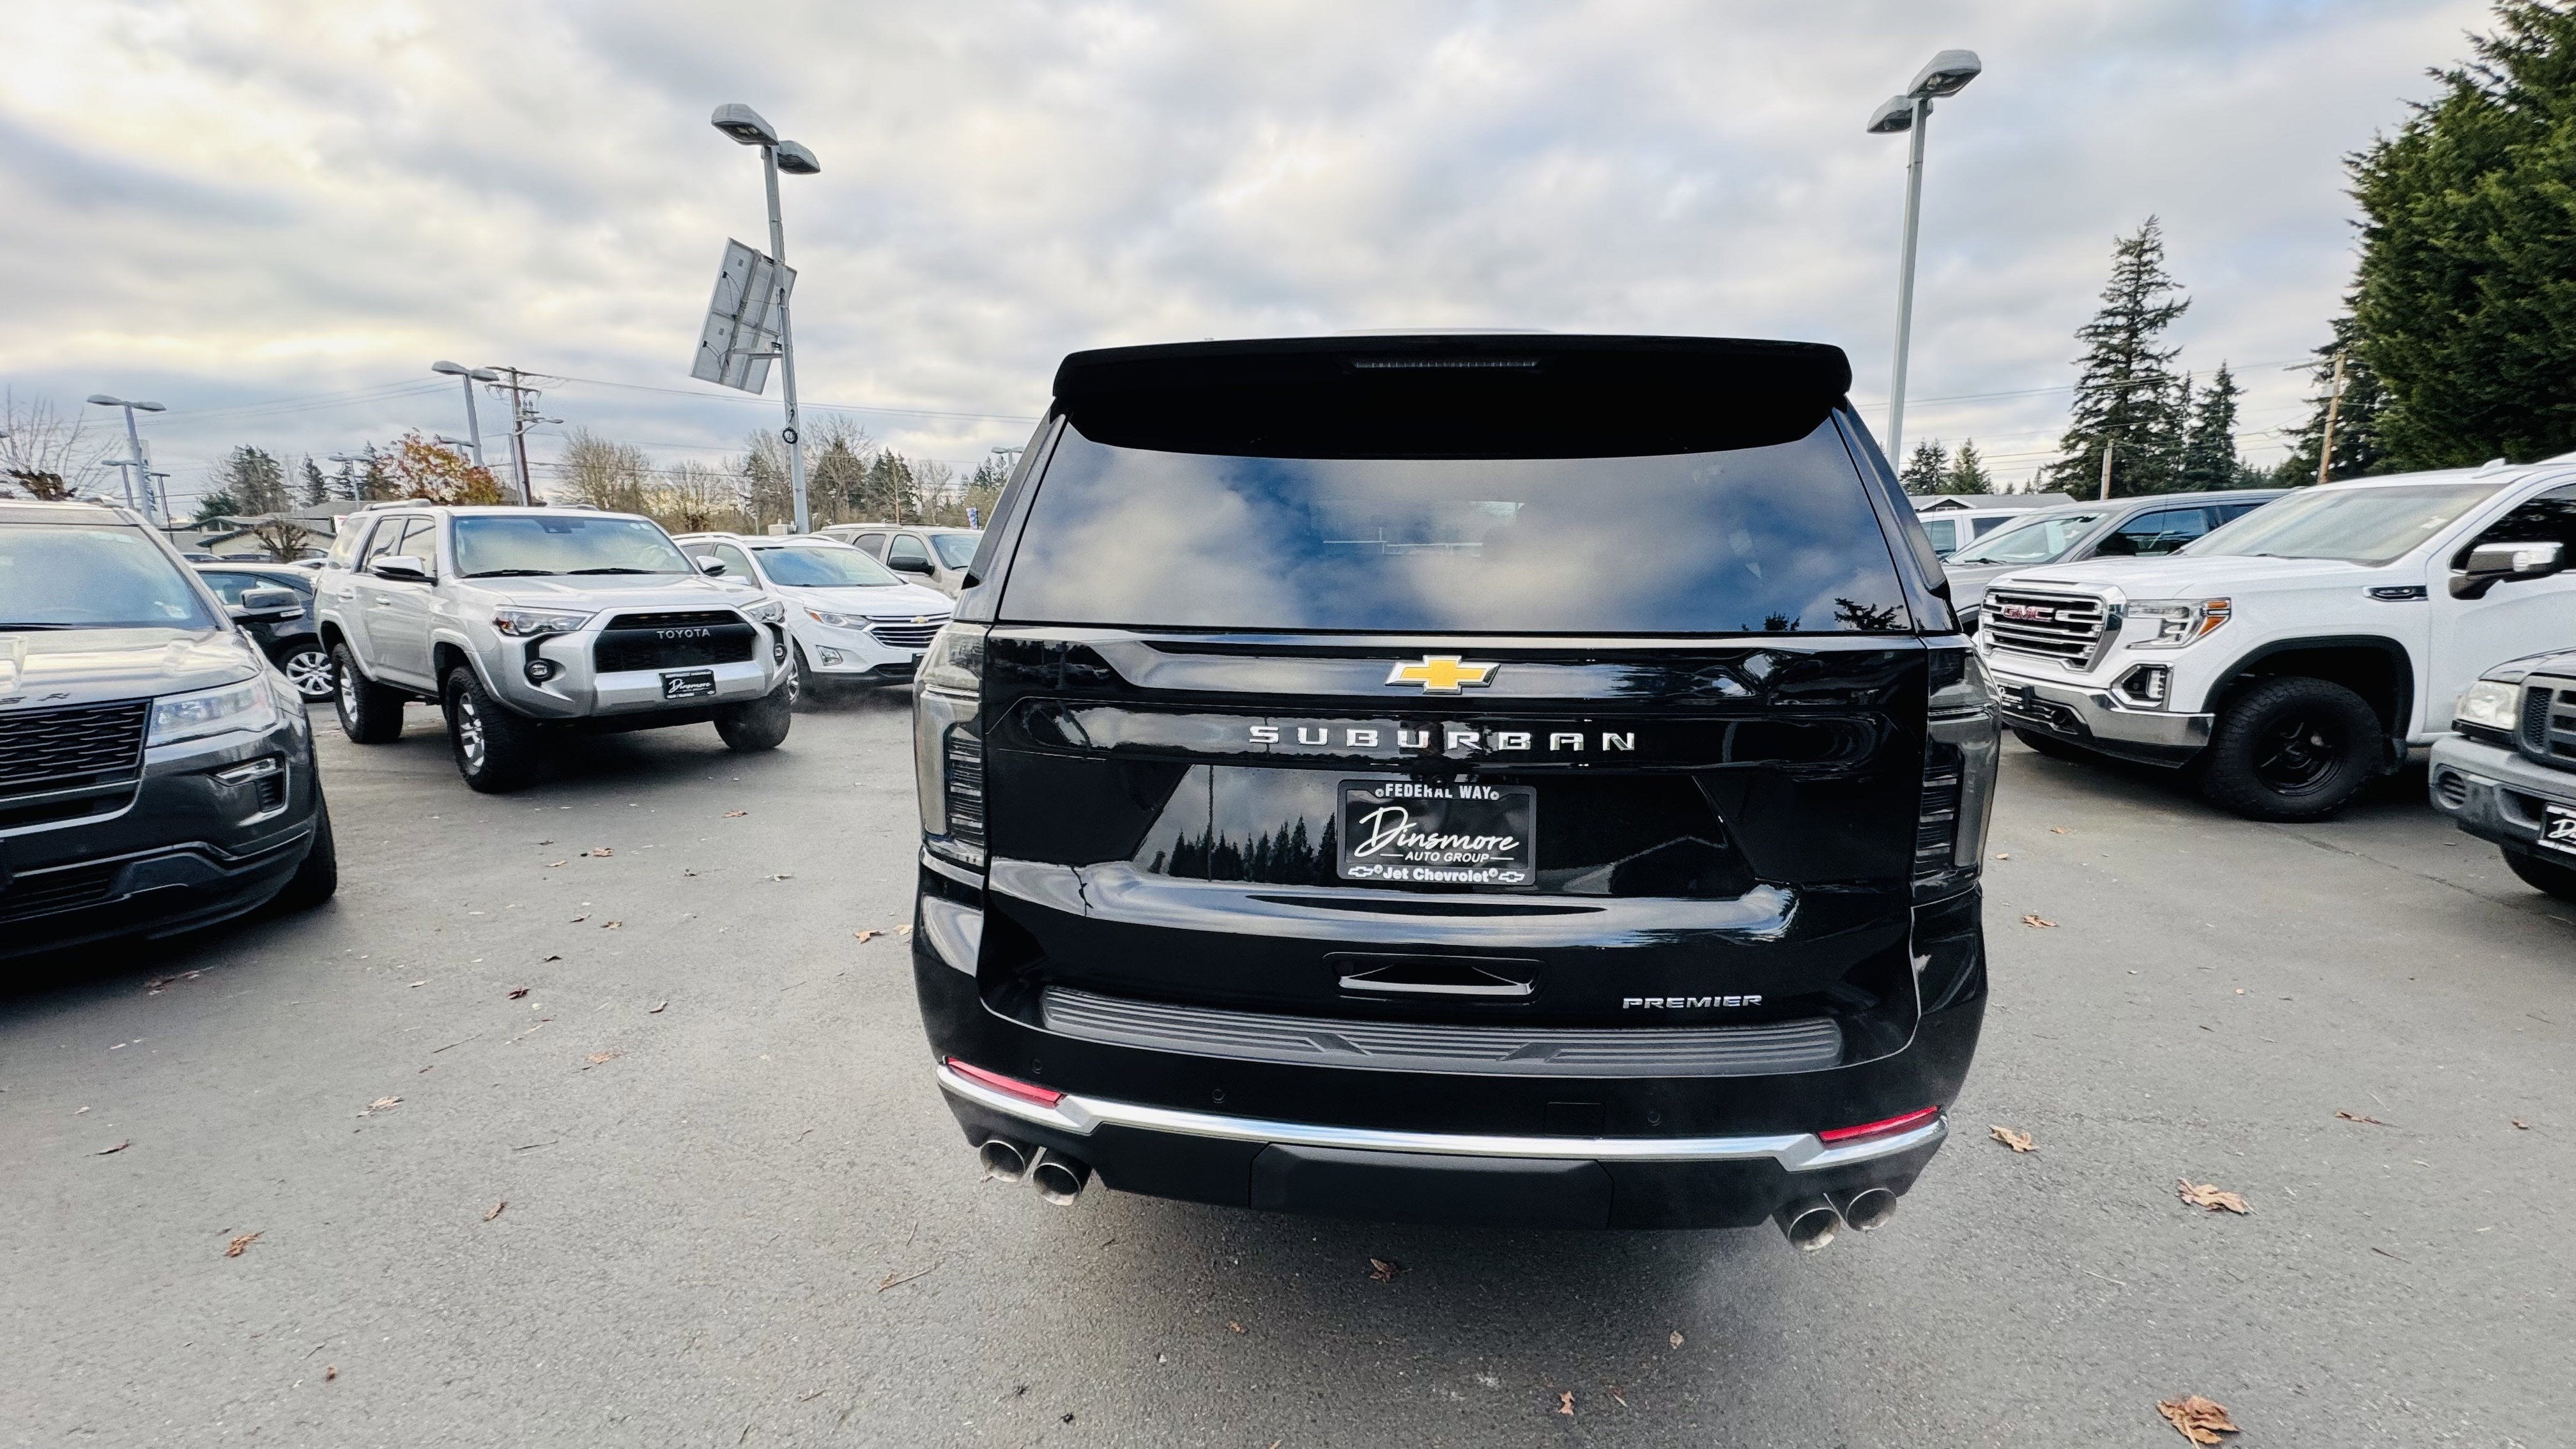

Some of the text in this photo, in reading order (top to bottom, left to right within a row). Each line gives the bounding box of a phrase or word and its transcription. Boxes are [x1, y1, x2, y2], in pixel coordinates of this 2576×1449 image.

[2003, 605, 2055, 622] GMC
[656, 628, 710, 640] TOYOTA
[1249, 726, 1635, 751] SUBURBAN
[1384, 783, 1491, 799] FEDERAL WAY
[1354, 806, 1520, 857] Dinsmore
[1405, 851, 1490, 863] AUTO GROUP
[1383, 866, 1490, 883] Jet Chevrolet
[1622, 995, 1763, 1009] PREMIER
